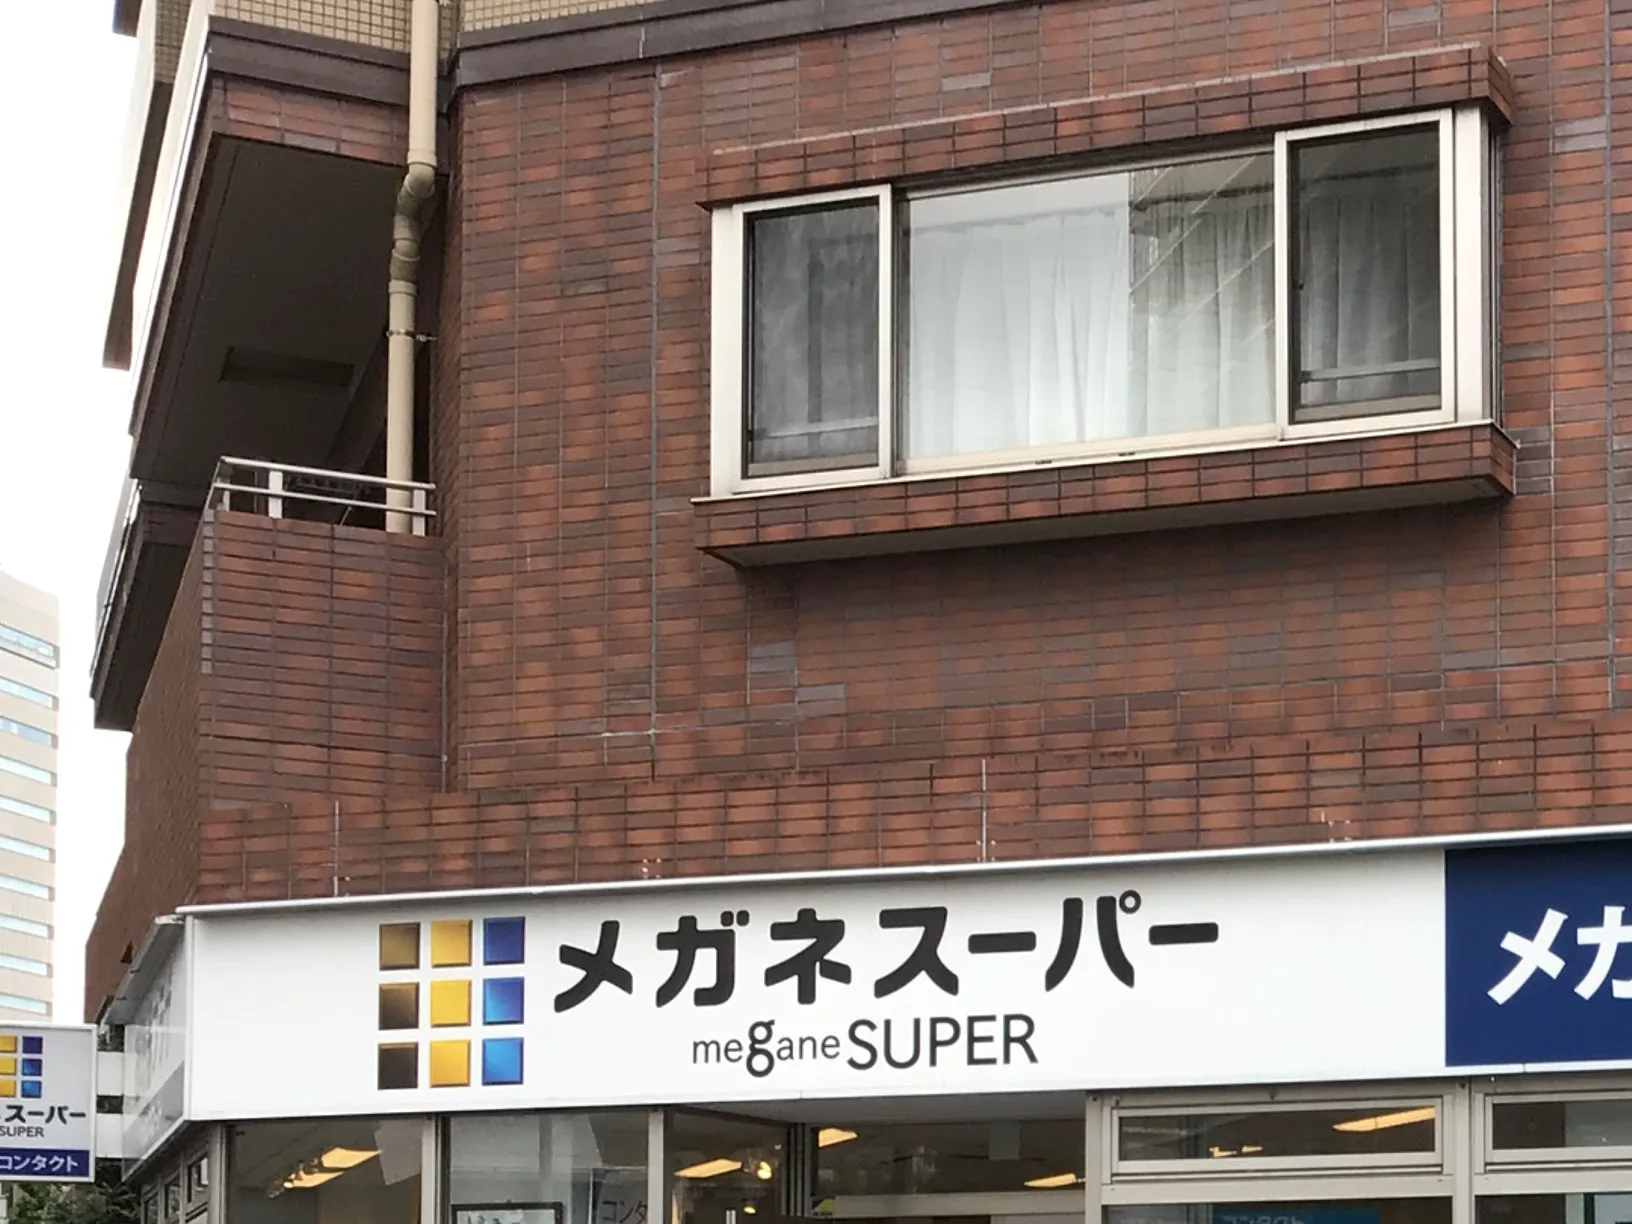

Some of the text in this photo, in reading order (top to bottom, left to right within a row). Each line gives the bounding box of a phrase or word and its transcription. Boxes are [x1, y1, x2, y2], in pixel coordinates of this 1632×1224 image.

[554, 889, 1219, 1013] メガネスーパー
